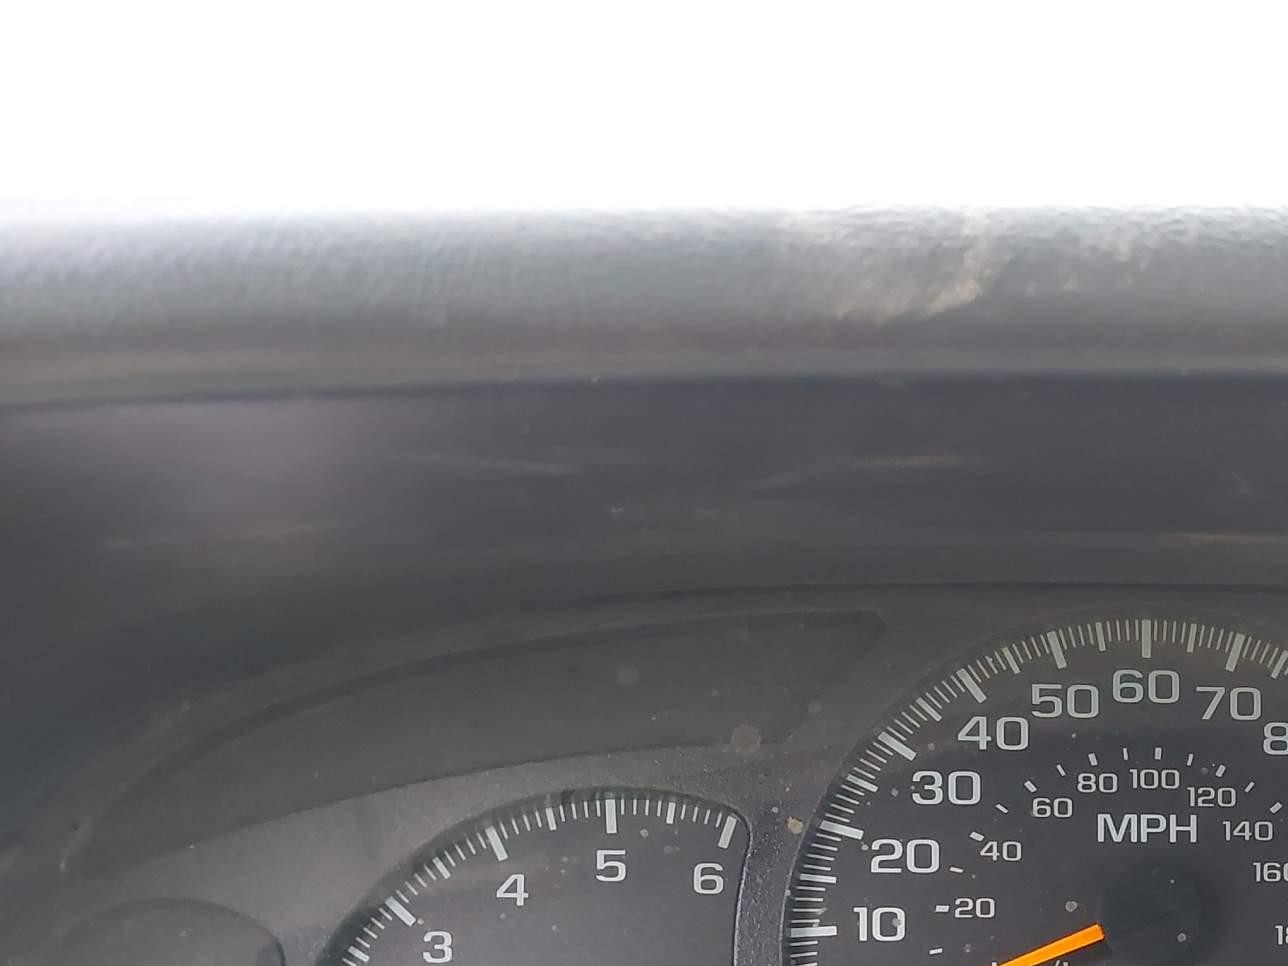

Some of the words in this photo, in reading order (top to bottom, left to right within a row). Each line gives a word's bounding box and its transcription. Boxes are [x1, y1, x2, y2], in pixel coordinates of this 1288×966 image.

[1032, 684, 1098, 718] 50
[1113, 670, 1179, 703] 60
[1196, 687, 1261, 720] 70
[958, 717, 1028, 750] 40
[912, 771, 980, 804] 30
[1078, 773, 1117, 792] 80
[1130, 769, 1179, 788] 100
[1033, 798, 1072, 817] 60
[1187, 787, 1235, 806] 120
[1098, 814, 1196, 842] MPH
[1223, 821, 1272, 840] 140
[596, 850, 626, 881] 5
[871, 839, 939, 873] 20
[979, 840, 1022, 861] 40
[497, 874, 528, 905] 4
[694, 863, 723, 894] 6
[955, 898, 994, 917] 20
[854, 907, 905, 941] 10
[423, 931, 452, 963] 3
